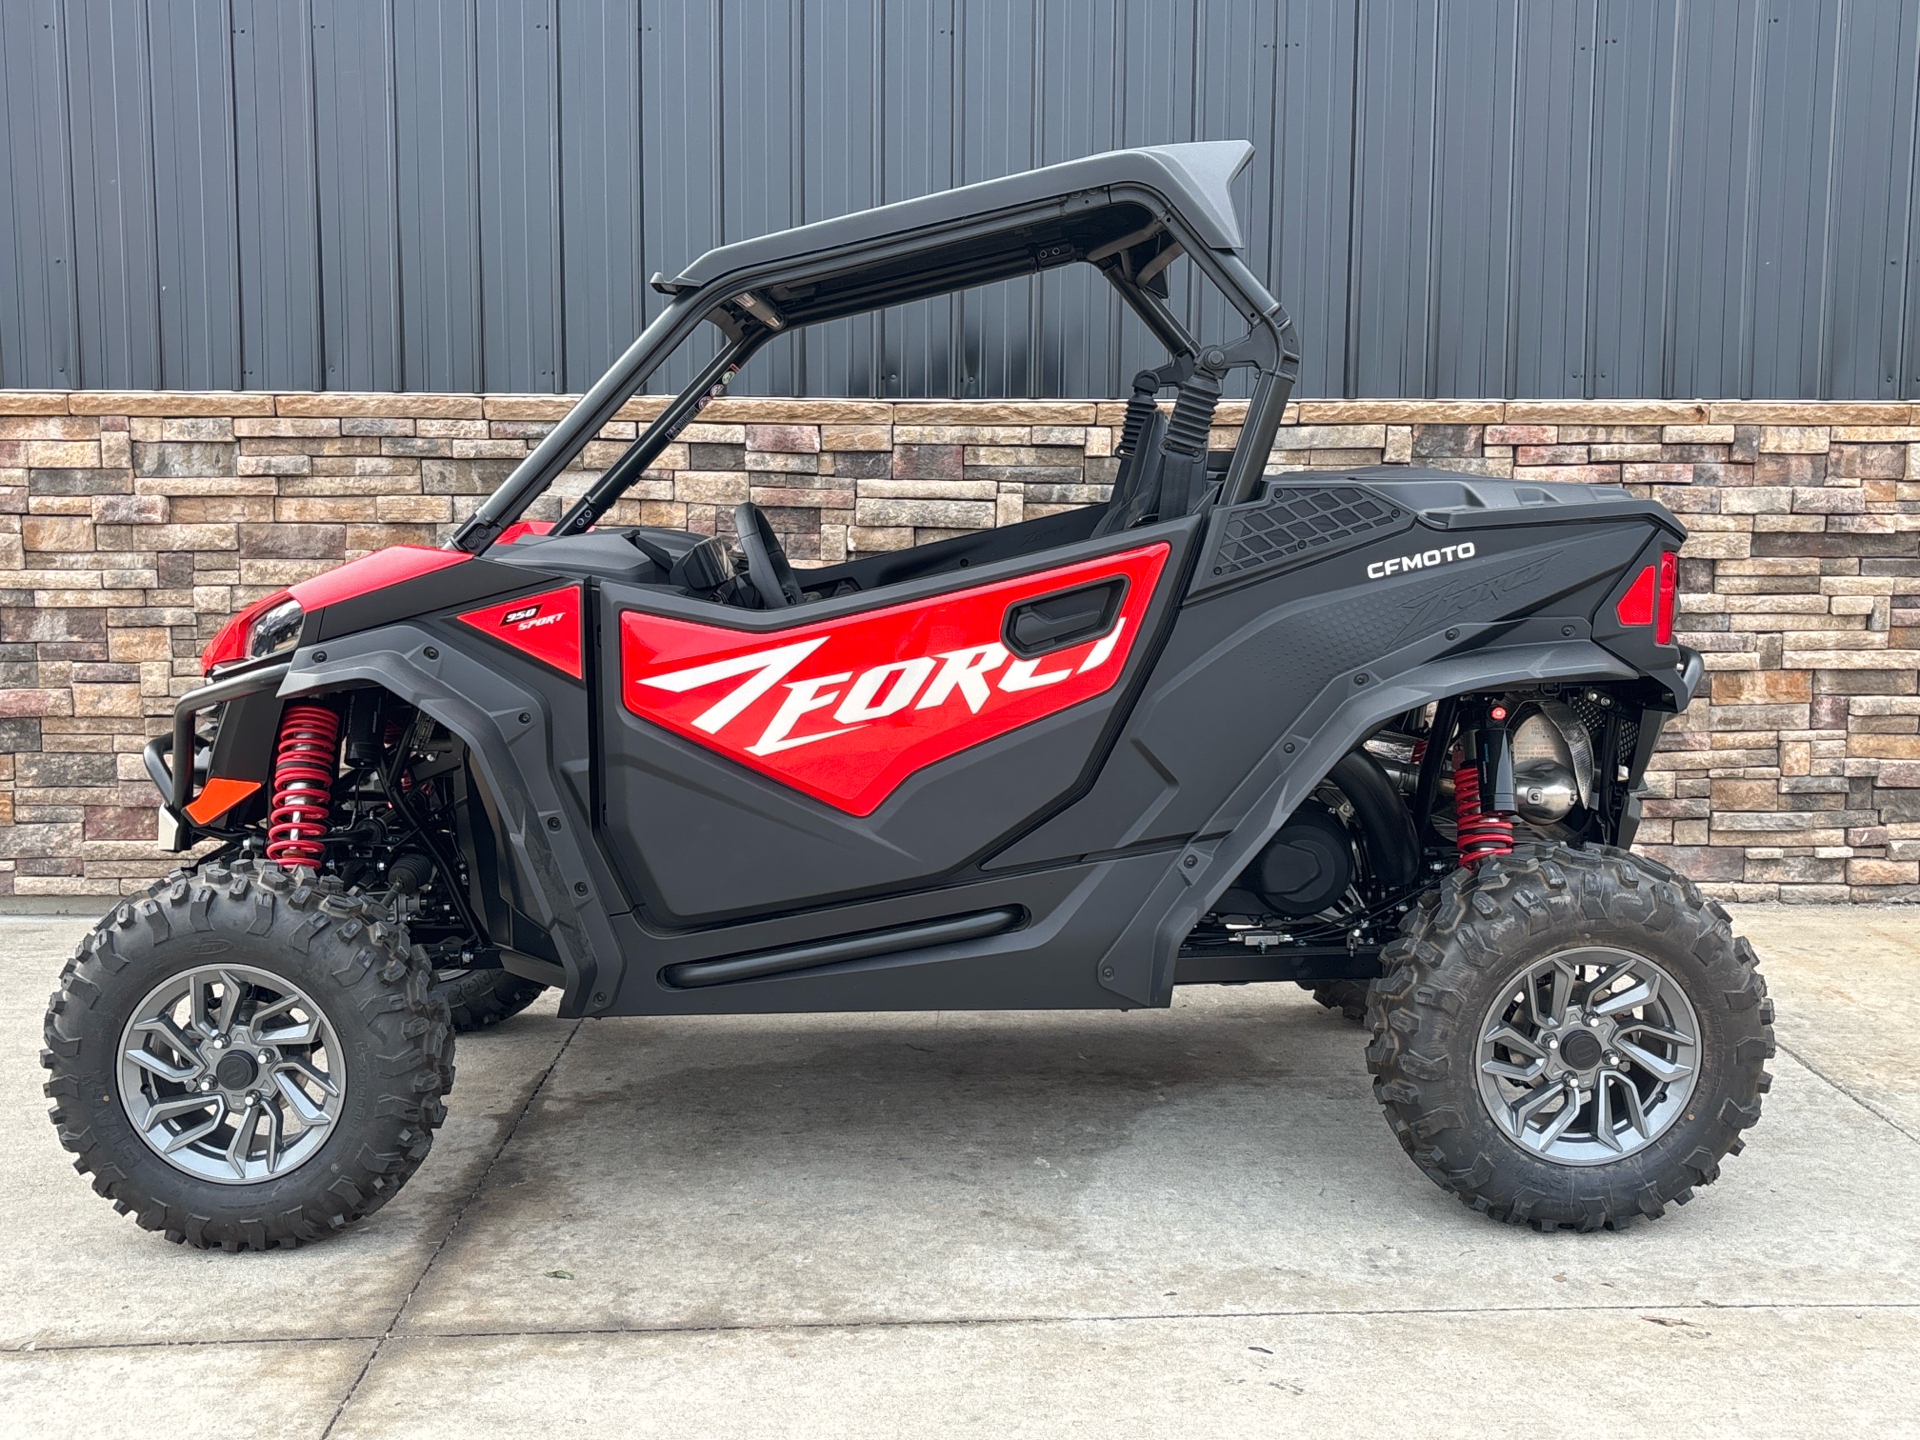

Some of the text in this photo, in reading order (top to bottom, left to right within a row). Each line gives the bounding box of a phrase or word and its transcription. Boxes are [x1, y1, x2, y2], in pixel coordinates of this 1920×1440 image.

[1366, 541, 1476, 579] CFMOTO
[505, 607, 538, 623] 950
[516, 612, 566, 631] SPORT
